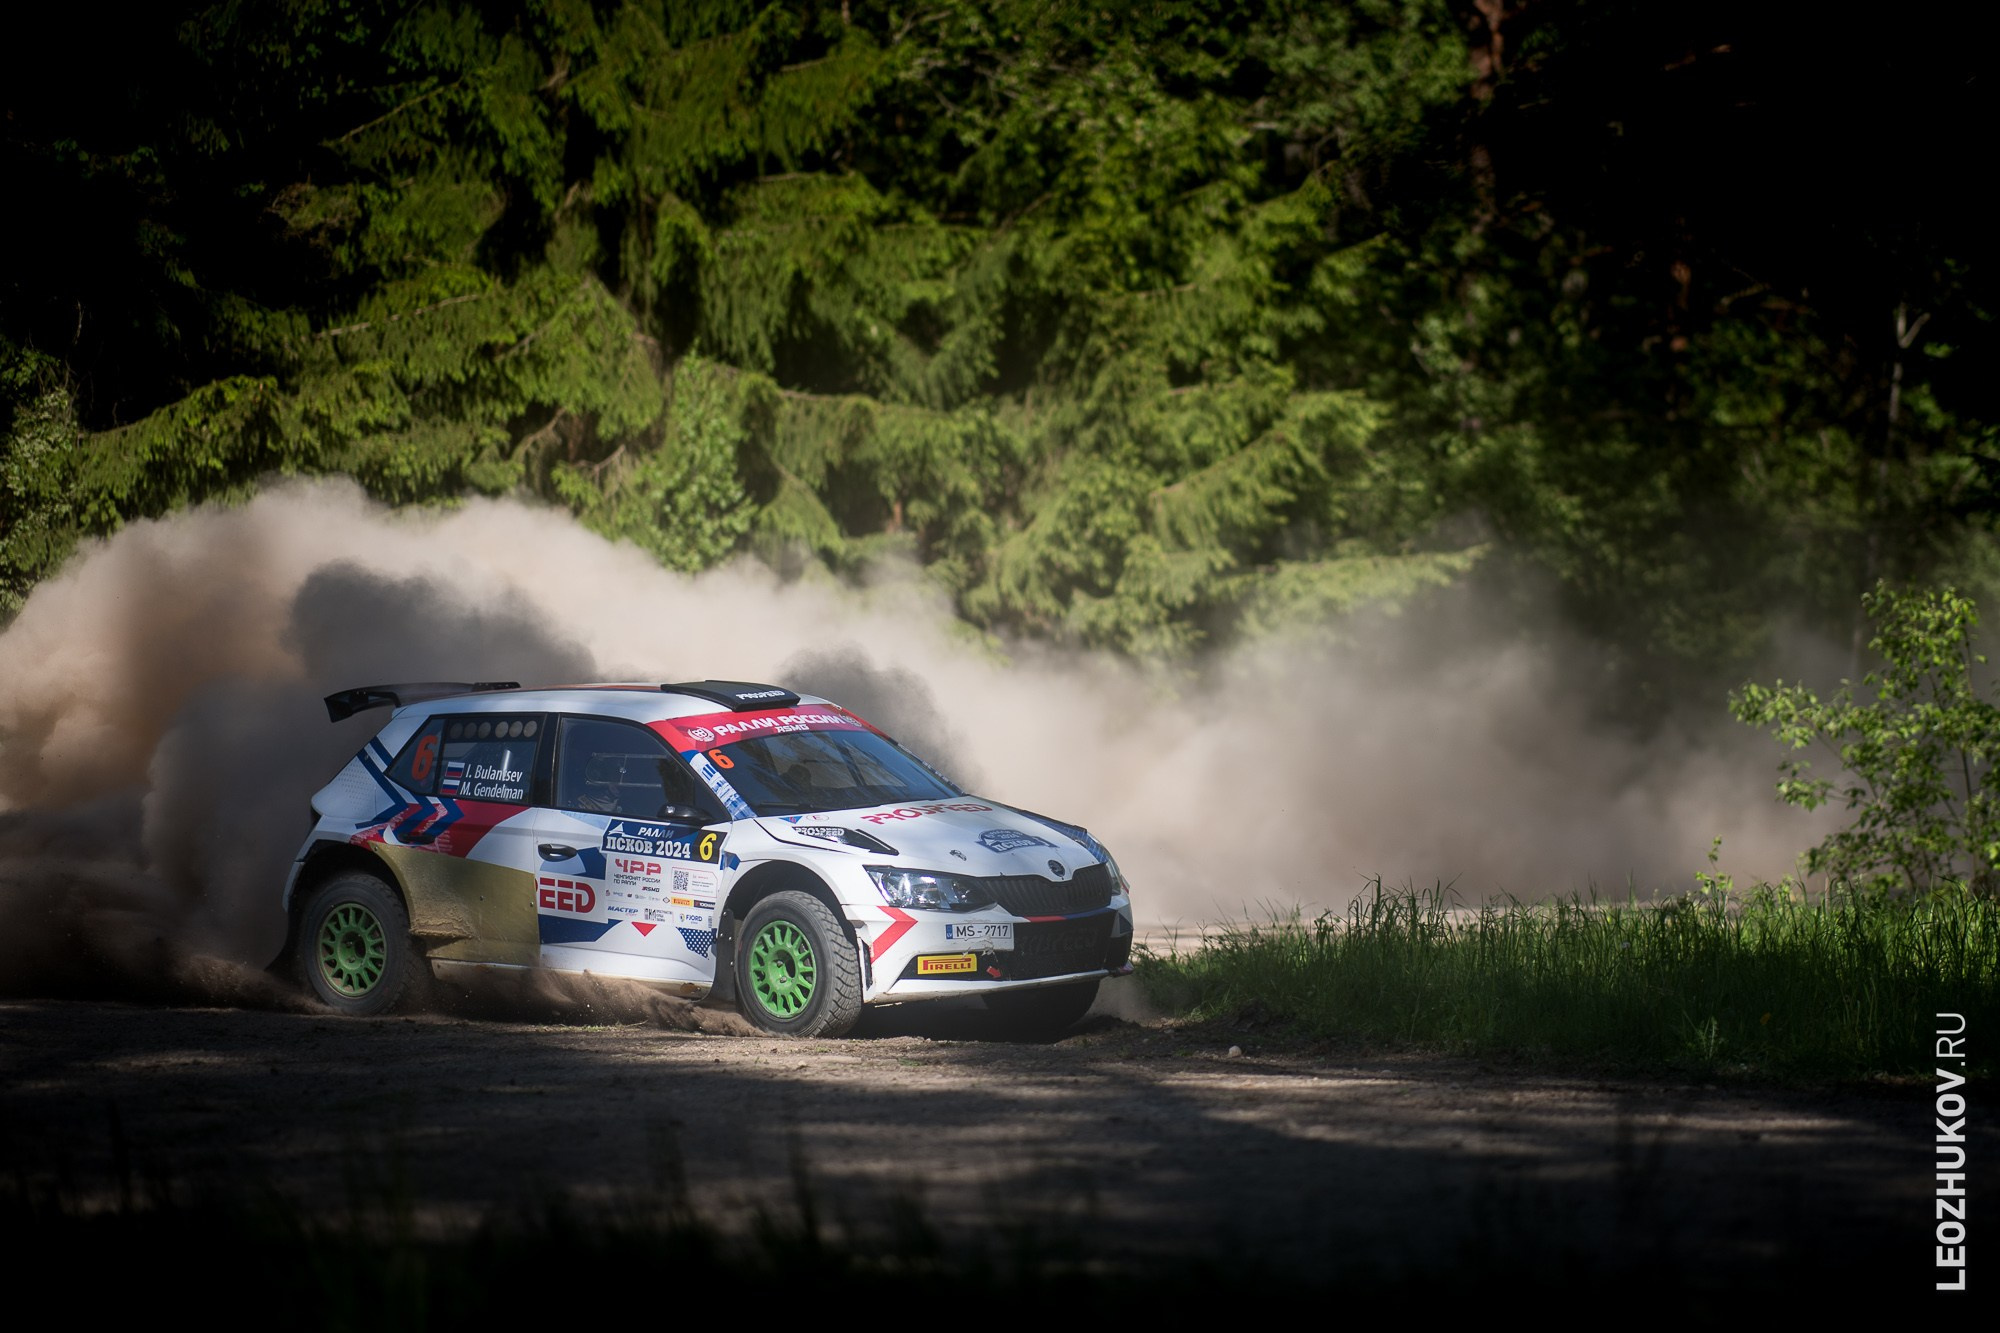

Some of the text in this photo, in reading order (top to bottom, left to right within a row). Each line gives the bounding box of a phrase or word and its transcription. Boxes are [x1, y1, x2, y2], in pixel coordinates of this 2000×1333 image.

[712, 714, 847, 737] РАЛЛИ РОССИИ
[411, 735, 438, 781] 6
[708, 749, 735, 769] 6
[465, 765, 523, 783] I. Bulantsev
[459, 782, 524, 800] M. Gendelman
[860, 804, 993, 824] PROSPEED
[637, 826, 675, 839] РАЛЛИ
[795, 827, 845, 836] PROSPEED
[606, 837, 691, 858] ПСКОВ 2024
[699, 833, 717, 861] 6
[991, 839, 1036, 852] ПСКОВ
[615, 859, 661, 875] ЧРР
[535, 877, 596, 914] EED
[607, 905, 639, 914] МАСТЕР
[922, 957, 972, 971] PIRELLI
